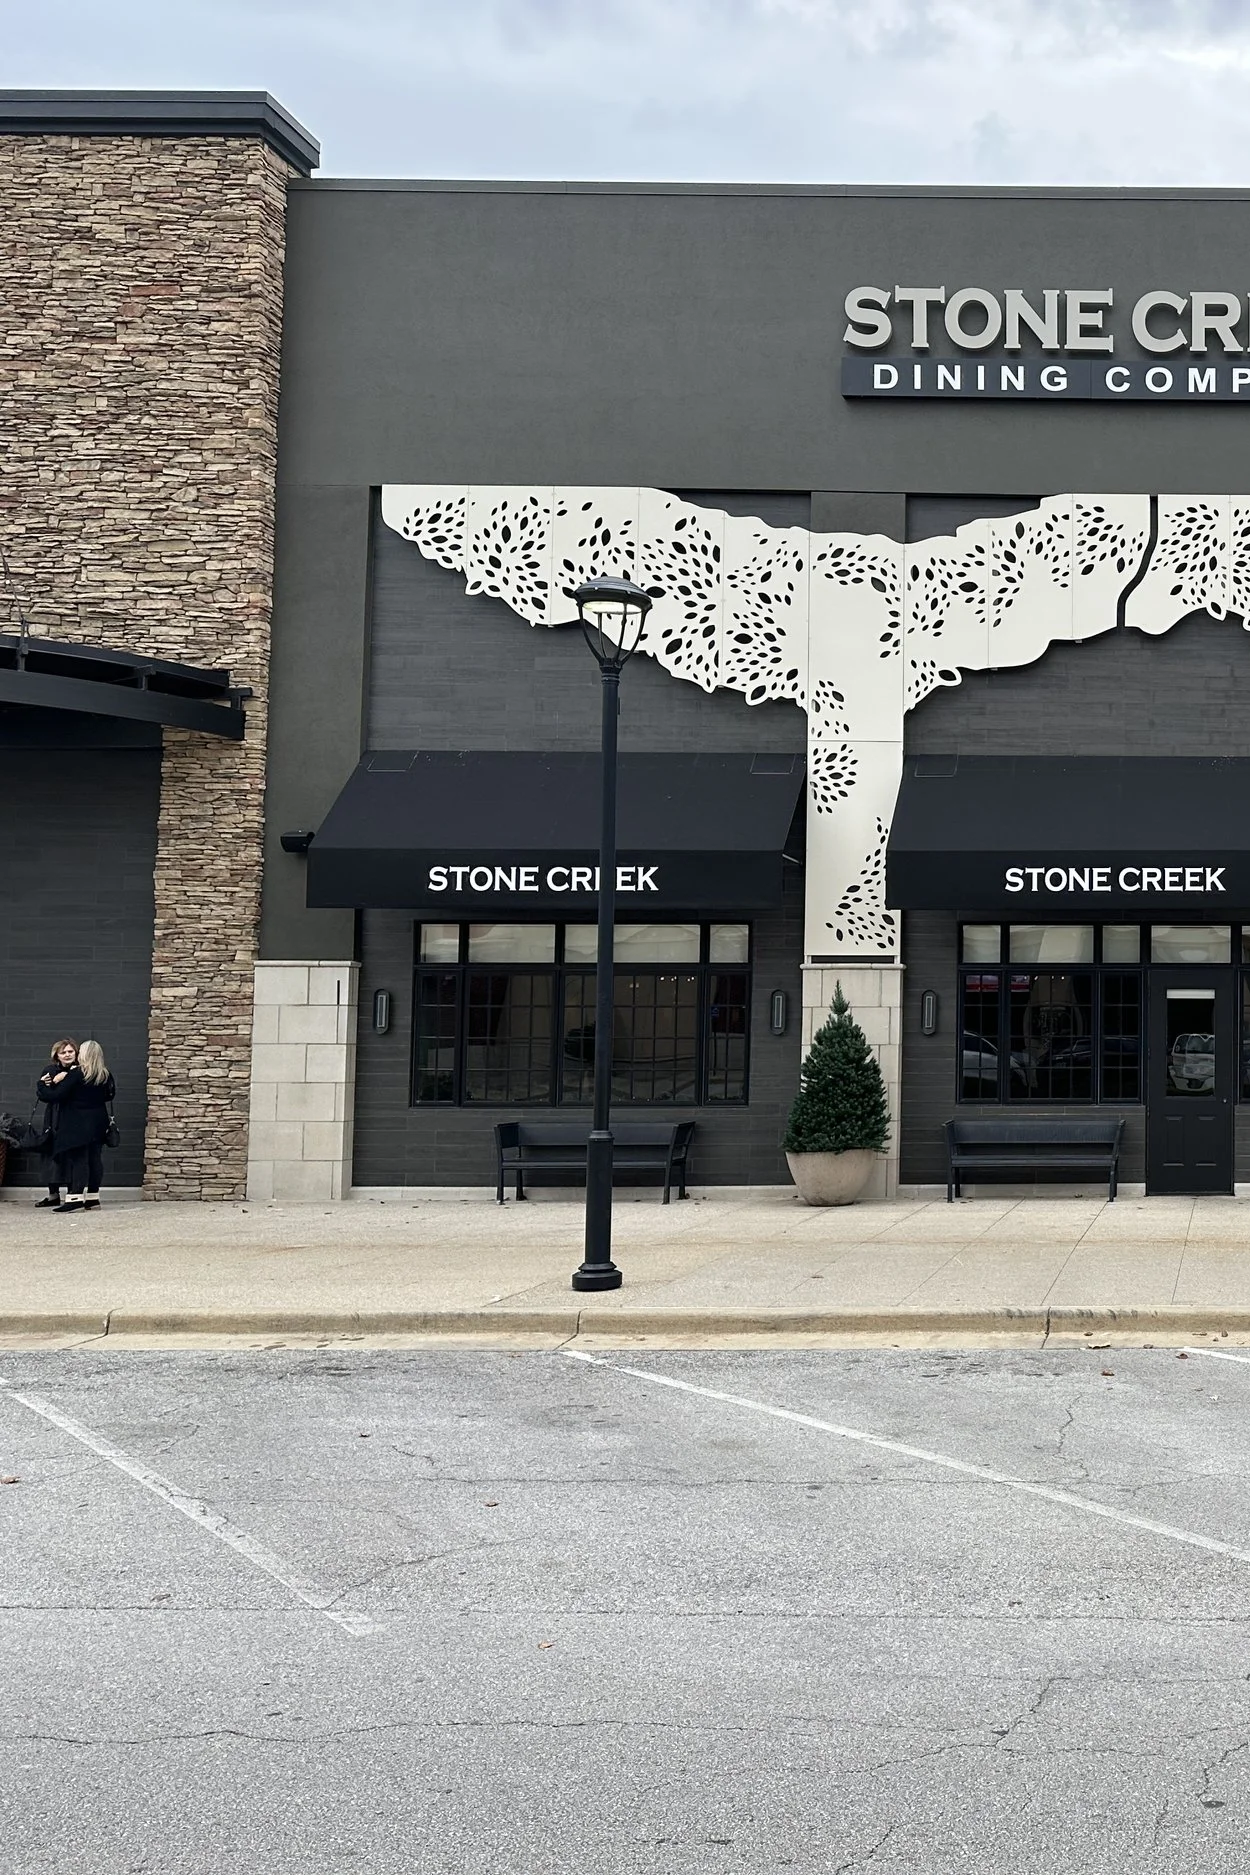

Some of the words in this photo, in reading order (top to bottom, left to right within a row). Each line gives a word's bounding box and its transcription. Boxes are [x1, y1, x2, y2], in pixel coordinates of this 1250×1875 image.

[842, 284, 1114, 353] STONE
[873, 363, 1068, 392] DINING
[427, 865, 539, 892] STONE
[1004, 866, 1112, 892] STONE
[1118, 866, 1227, 892] CREEK
